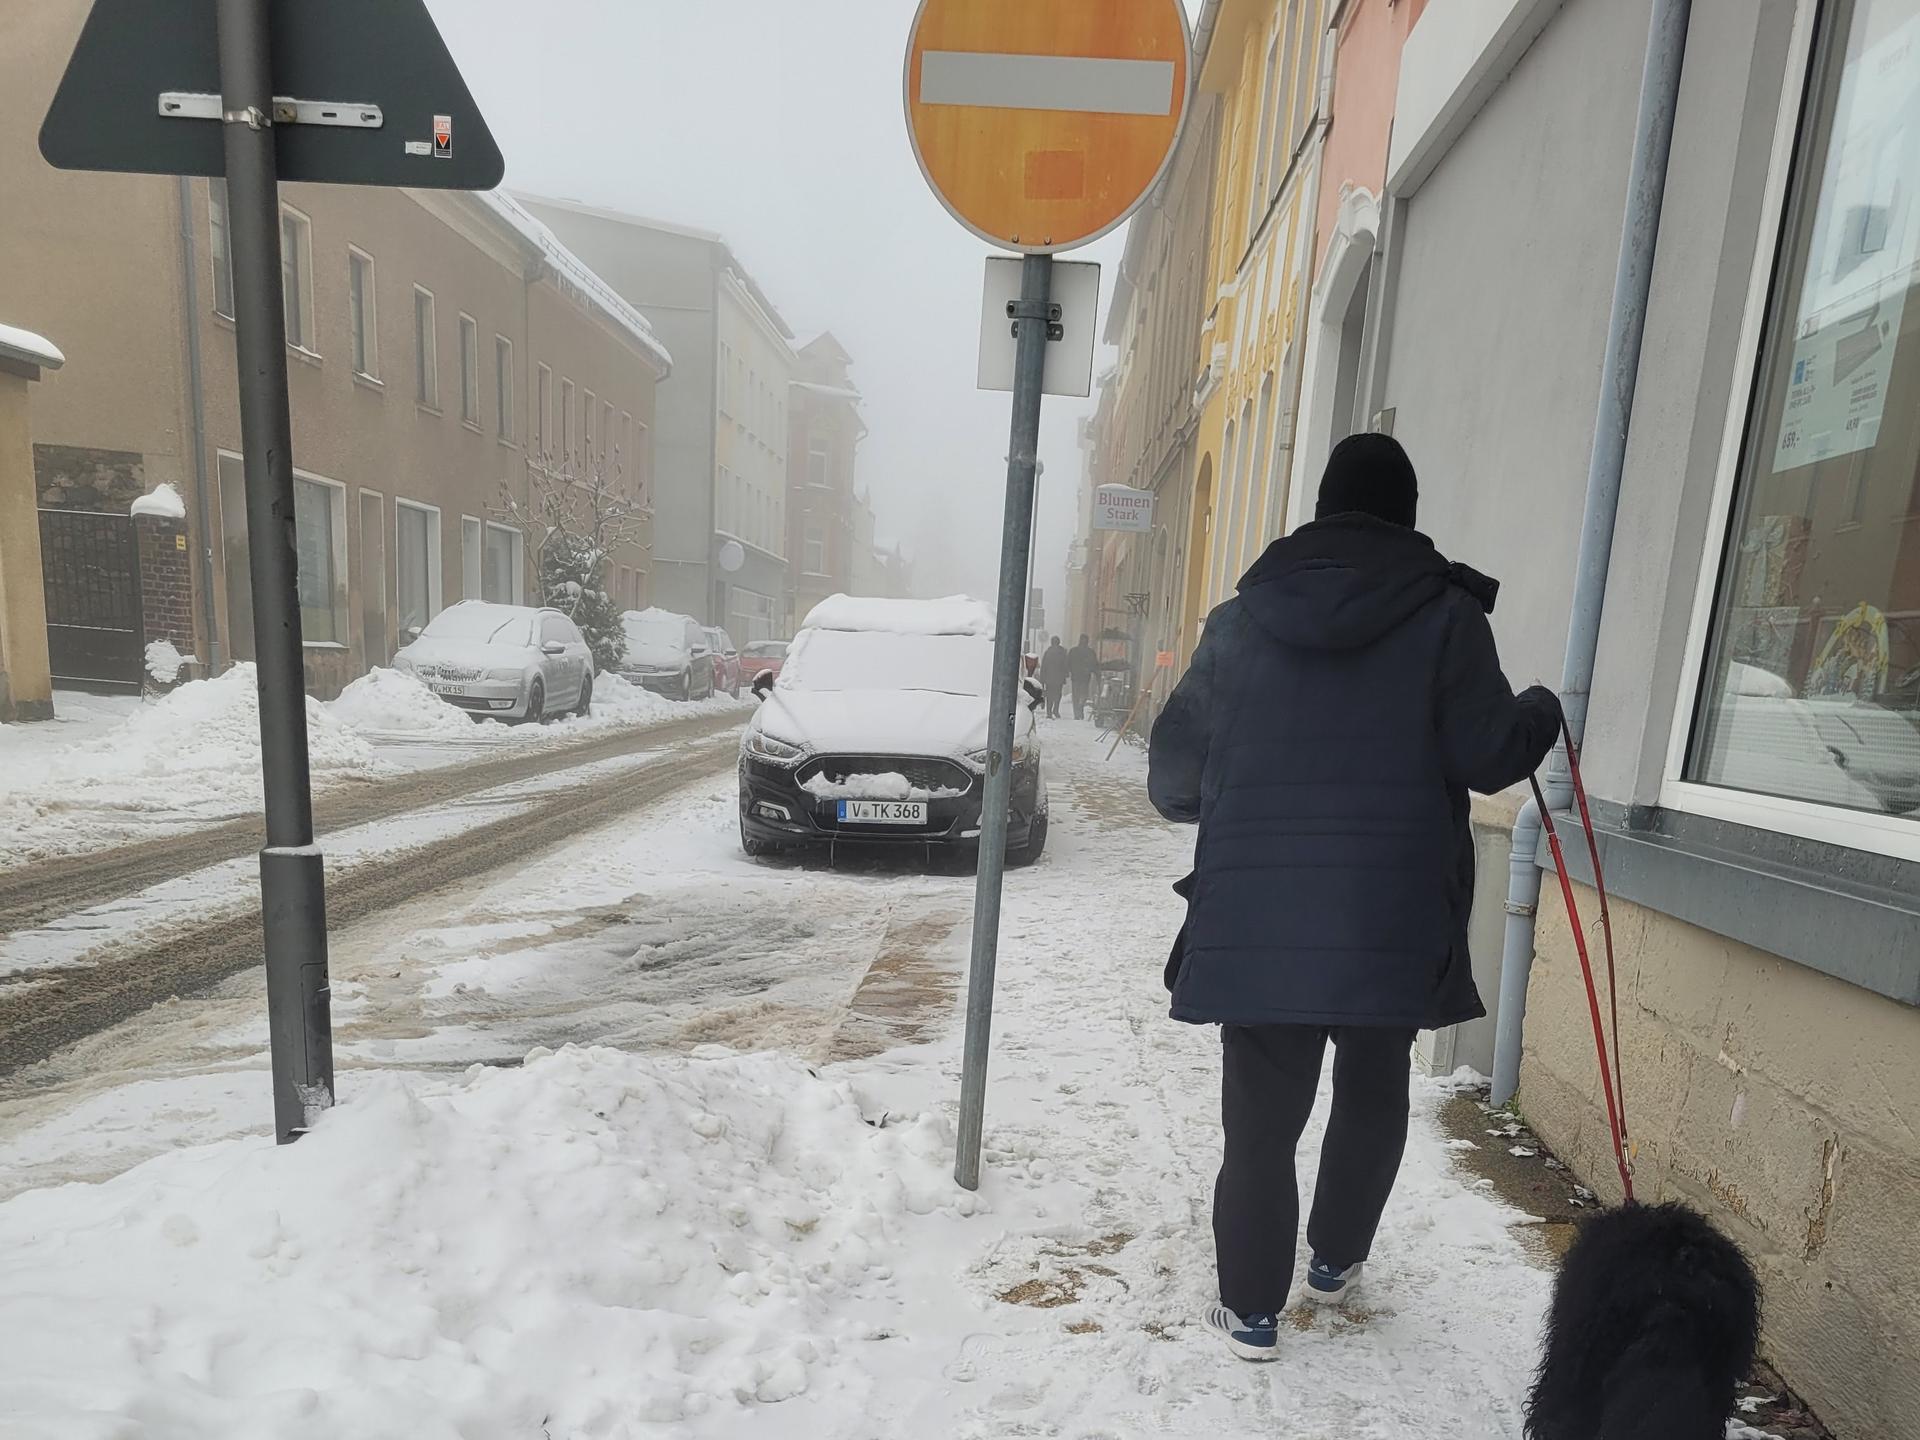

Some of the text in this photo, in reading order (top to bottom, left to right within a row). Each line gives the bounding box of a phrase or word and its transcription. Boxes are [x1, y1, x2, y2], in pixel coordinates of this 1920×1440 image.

[1098, 492, 1150, 508] Blumen
[1106, 507, 1138, 520] Stark
[852, 803, 861, 817] V
[872, 803, 890, 818] TK
[894, 804, 920, 819] 368
